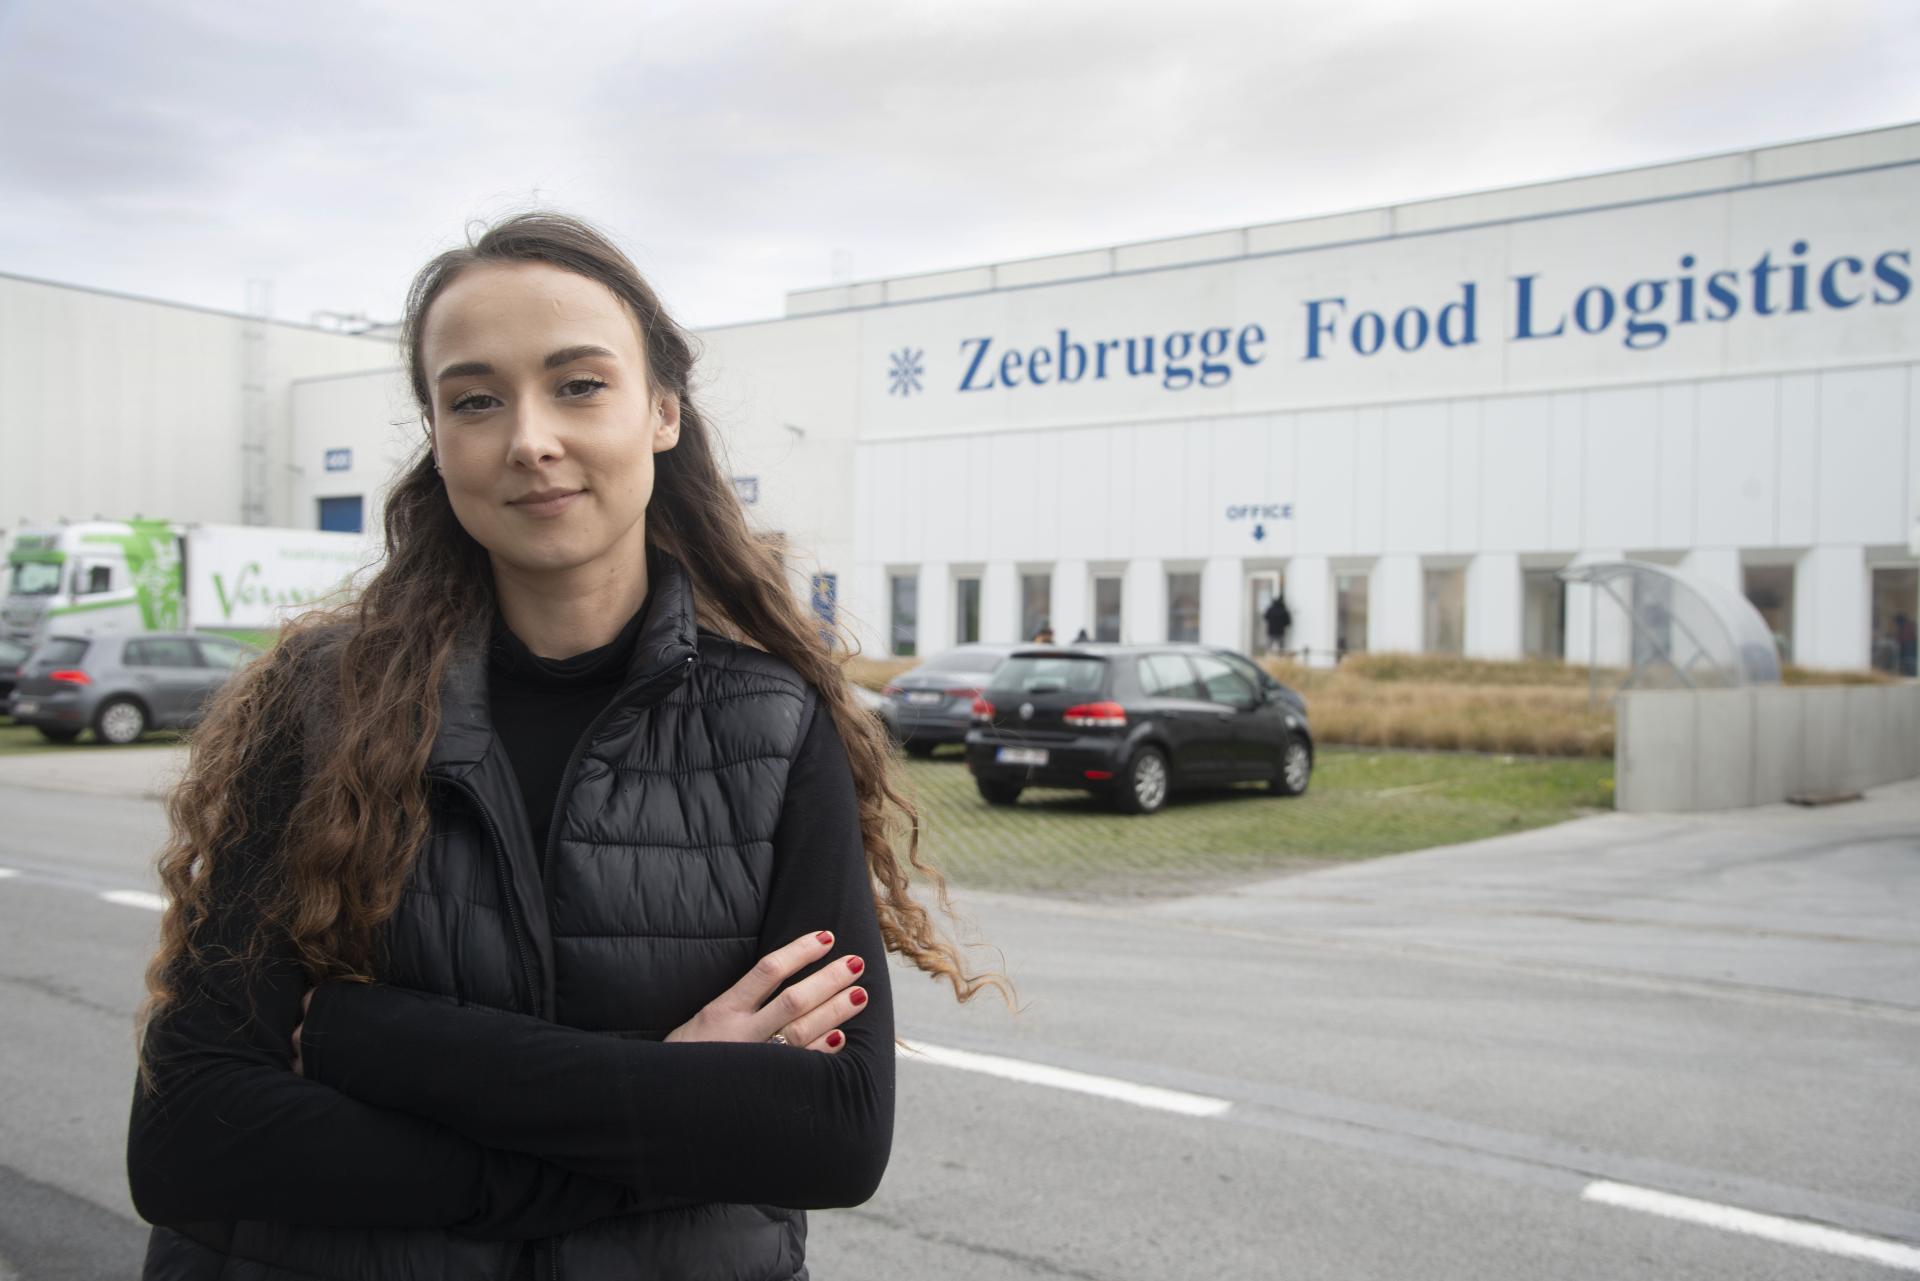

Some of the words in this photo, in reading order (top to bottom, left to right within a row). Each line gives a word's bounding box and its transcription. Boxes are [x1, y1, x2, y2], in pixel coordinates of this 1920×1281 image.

[958, 321, 1267, 393] Zeebrugge
[1303, 281, 1480, 363] Food
[1508, 240, 1914, 351] Logistics
[1226, 504, 1293, 520] OFFICE
